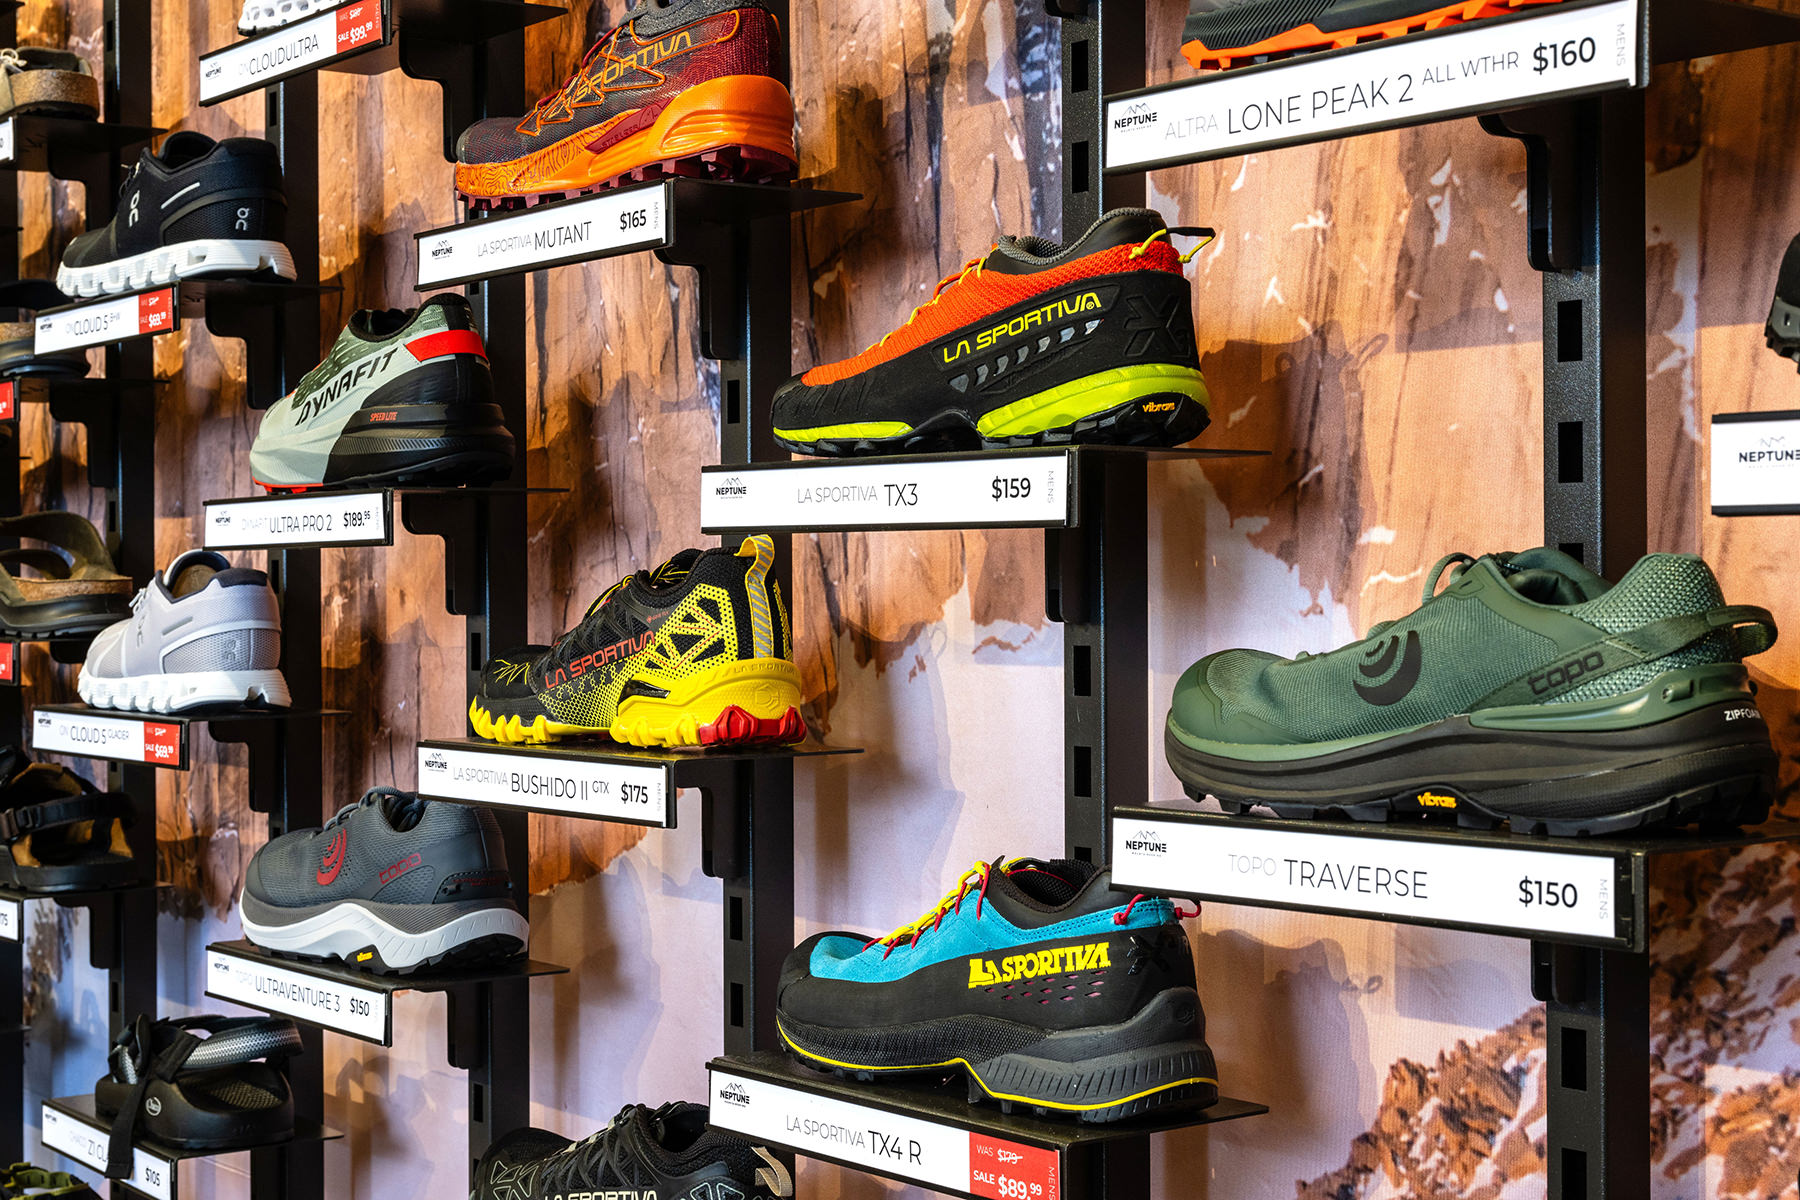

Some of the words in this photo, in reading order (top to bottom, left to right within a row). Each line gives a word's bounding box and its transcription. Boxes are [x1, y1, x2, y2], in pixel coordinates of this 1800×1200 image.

[337, 31, 350, 43] SALE
[349, 21, 373, 45] $99.99
[1616, 23, 1626, 67] MENS
[248, 34, 320, 76] CLOUDULTRA
[1164, 113, 1219, 141] ALTRA
[1228, 94, 1302, 135] LONE
[1312, 77, 1390, 119] PEAK
[1397, 73, 1414, 103] 2
[1421, 64, 1456, 85] ALL
[1460, 51, 1519, 78] WTHR
[1532, 36, 1596, 75] $160
[1114, 111, 1158, 129] NEPTUNE
[477, 242, 489, 257] LA
[490, 234, 532, 254] SPORTIVA
[534, 221, 592, 251] MUTANT
[619, 208, 647, 232] $165
[431, 246, 453, 257] NEPTUNE
[73, 316, 103, 336] CLOUD
[103, 315, 109, 330] 5
[943, 338, 971, 364] LA
[976, 291, 1102, 351] SPORTIVA
[295, 348, 398, 427] DYNAFIT
[1739, 449, 1800, 463] NEPTUNE
[715, 486, 747, 496] NEPTUNE
[797, 488, 812, 504] LA
[815, 485, 878, 503] SPORTIVA
[883, 483, 919, 507] TX3
[991, 475, 1031, 502] $159
[1047, 470, 1055, 504] MENS
[269, 515, 300, 534] ULTRA
[302, 514, 325, 533] PRO
[326, 514, 333, 531] 2
[343, 510, 371, 529] $189.95
[544, 666, 568, 689] LA
[569, 630, 656, 679] SPORTIVA
[1526, 650, 1605, 696] topo
[70, 725, 100, 744] CLOUD
[101, 729, 107, 745] 5
[424, 760, 448, 770] NEPTUNE
[452, 767, 464, 781] LA
[465, 768, 508, 785] SPORTIVA
[511, 772, 577, 799] BUSHIDO
[580, 780, 588, 801] II
[592, 780, 610, 795] GTX
[620, 781, 649, 804] $175
[1125, 840, 1167, 853] NEPTUNE
[379, 852, 422, 885] topo
[1227, 853, 1277, 876] TOPO
[1283, 858, 1429, 900] TRAVERSE
[1518, 875, 1578, 908] $150
[1599, 878, 1609, 920] MENS
[968, 958, 1003, 989] LA
[1002, 941, 1111, 983] SPORTIVA
[255, 974, 332, 1011] ULTRAVENTURE
[334, 995, 341, 1013] 3
[350, 996, 370, 1017] $150
[719, 1089, 750, 1105] NEPTUNE
[786, 1114, 802, 1133] LA
[803, 1118, 866, 1149] SPORTIVA
[867, 1129, 903, 1160] TX4
[909, 1139, 922, 1165] R
[976, 1144, 993, 1157] WAS
[145, 1167, 161, 1187] $105
[973, 1169, 995, 1185] SALE
[998, 1174, 1043, 1200] $89.99
